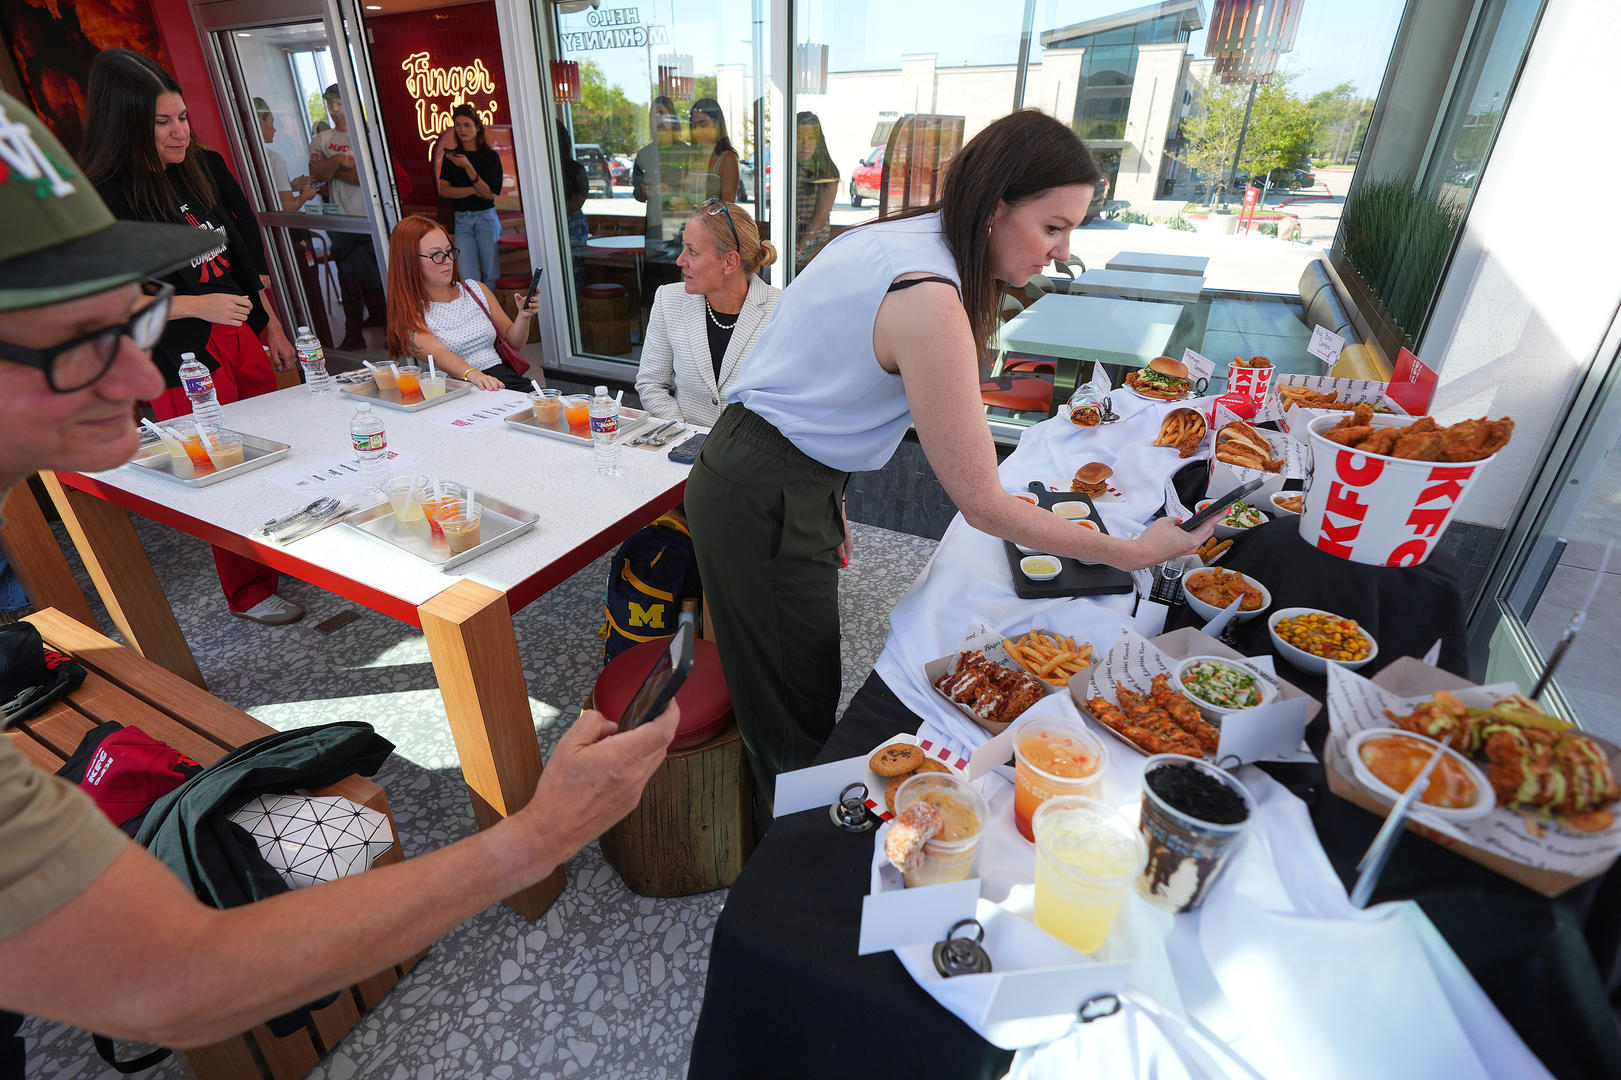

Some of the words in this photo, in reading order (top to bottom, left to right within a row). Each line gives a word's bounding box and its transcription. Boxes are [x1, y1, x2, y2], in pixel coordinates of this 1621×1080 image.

[401, 51, 496, 106] Finger
[1236, 369, 1253, 394] KF
[1254, 369, 1272, 409] KFC
[1317, 450, 1384, 560] KFC
[628, 602, 665, 628] M
[984, 641, 1001, 652] Finger
[88, 750, 107, 784] KFC
